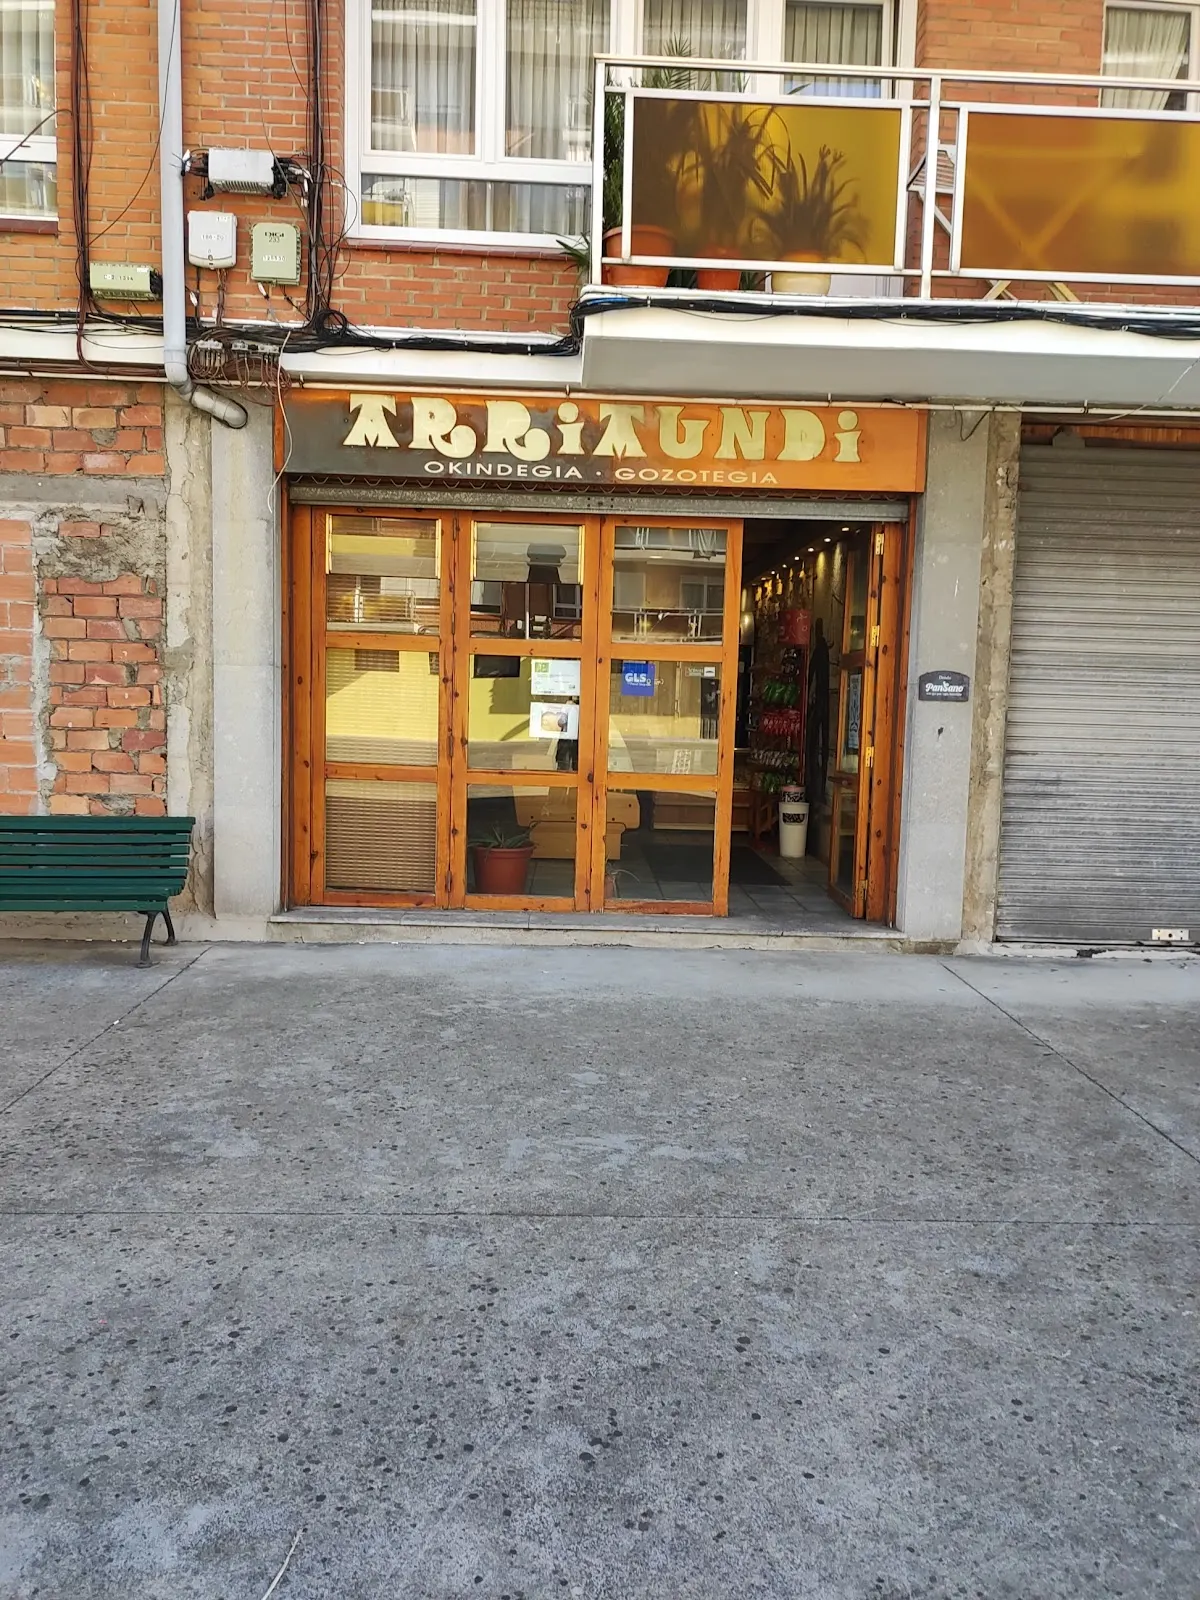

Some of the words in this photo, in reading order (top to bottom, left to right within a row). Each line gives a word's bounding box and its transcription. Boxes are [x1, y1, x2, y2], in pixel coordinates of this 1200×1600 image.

[424, 461, 583, 479] OKINDEGIA
[614, 467, 779, 484] GOZOTEGIA
[624, 672, 647, 683] GLS
[925, 681, 964, 692] PanSano
